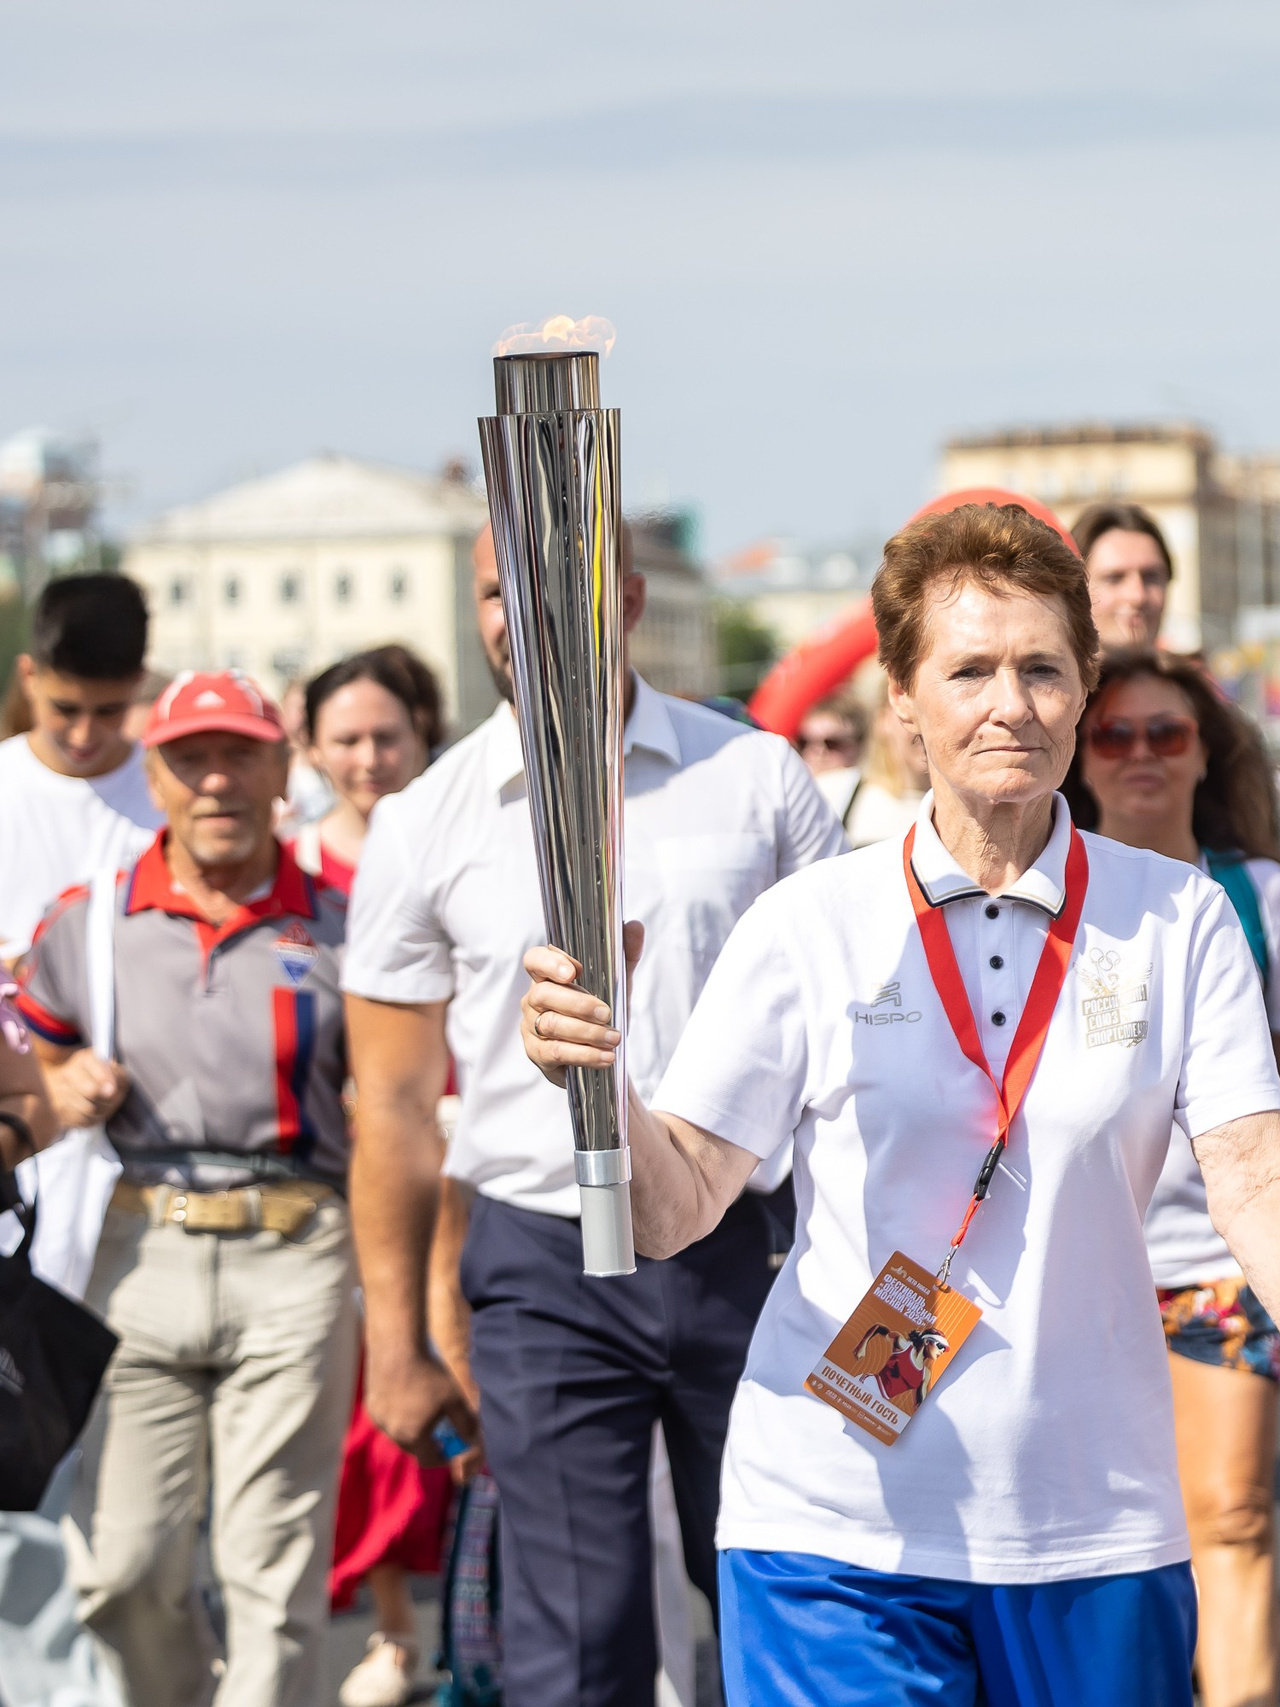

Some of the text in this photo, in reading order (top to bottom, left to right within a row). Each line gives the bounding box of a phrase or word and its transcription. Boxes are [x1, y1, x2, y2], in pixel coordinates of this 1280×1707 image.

[855, 1011, 923, 1026] HISPO
[1088, 1011, 1119, 1030] СОЮЗ
[1088, 1021, 1148, 1047] СПОРТСМЕ
[873, 1286, 906, 1313] МОСКВА
[883, 1273, 926, 1308] ФЕСТИВАЛЬ
[821, 1365, 874, 1406] ПОЧЕТНЫЙ
[870, 1399, 899, 1425] ГОСТЬ
